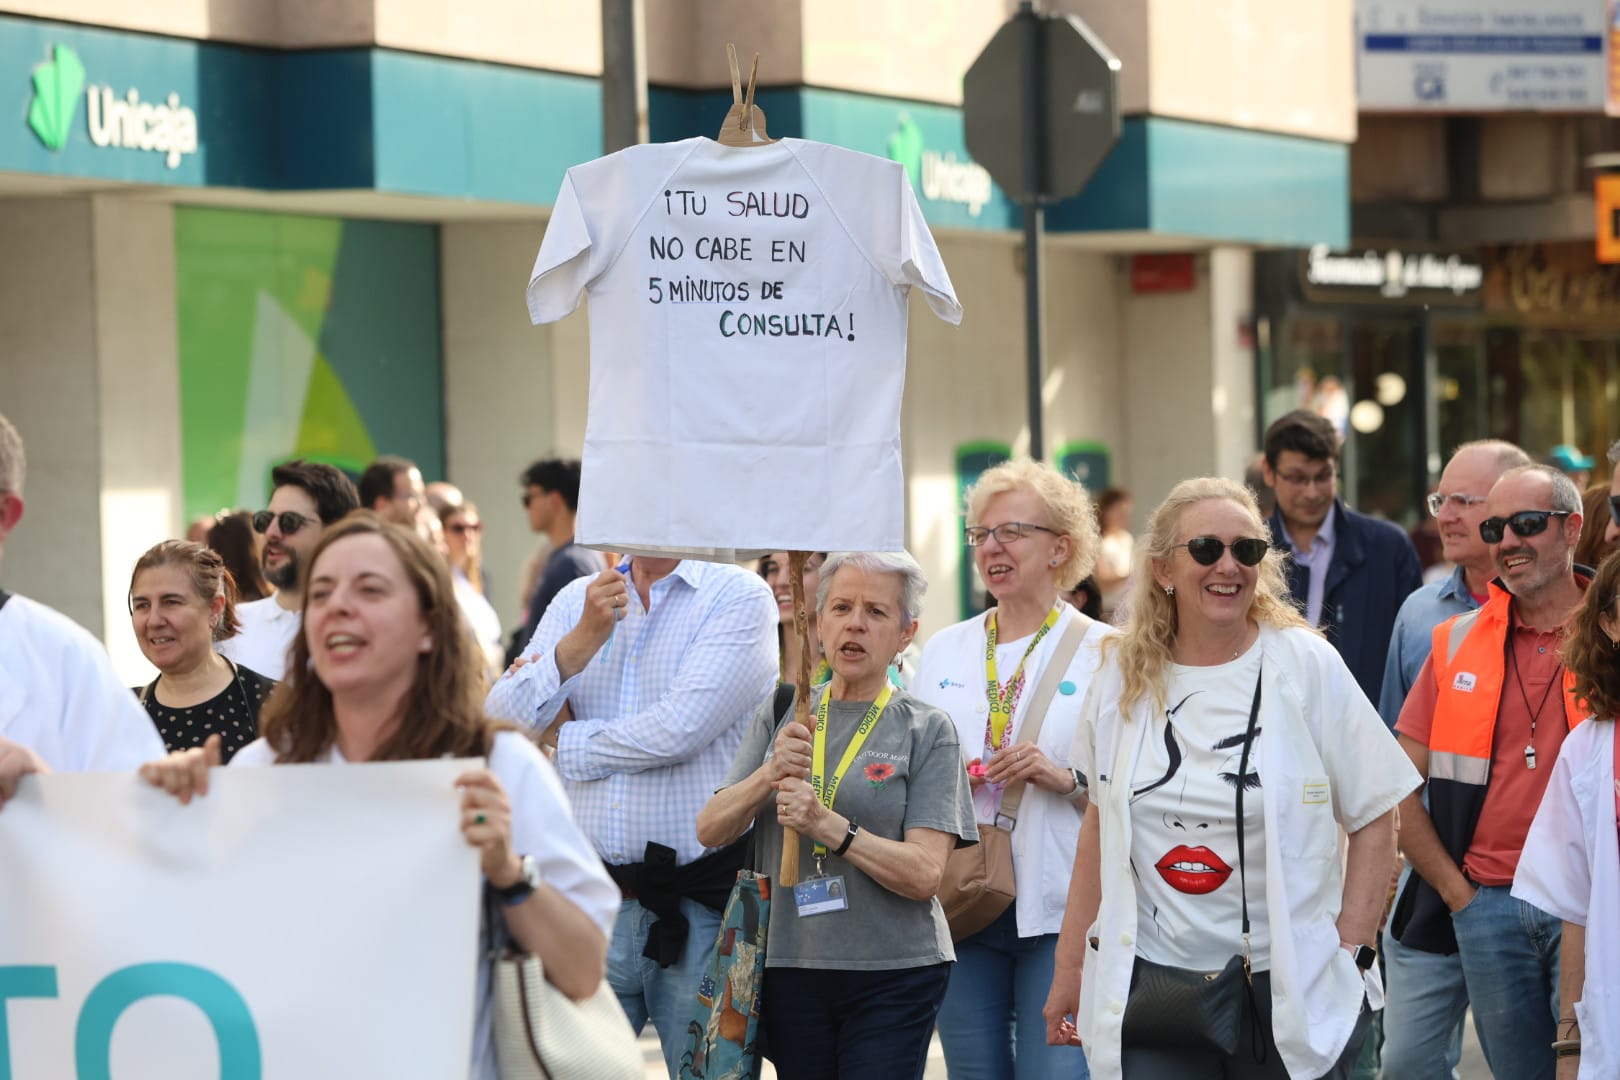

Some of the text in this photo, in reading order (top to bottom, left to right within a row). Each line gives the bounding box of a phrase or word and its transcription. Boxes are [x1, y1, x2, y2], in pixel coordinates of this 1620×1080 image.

[87, 84, 198, 169] Unicaja
[726, 191, 809, 218] SALUD
[650, 236, 806, 262] NO CABE EN
[649, 277, 662, 304] 5
[760, 281, 784, 300] DE
[719, 310, 855, 342] CONSULTA!
[823, 775, 839, 809] MÉDIC
